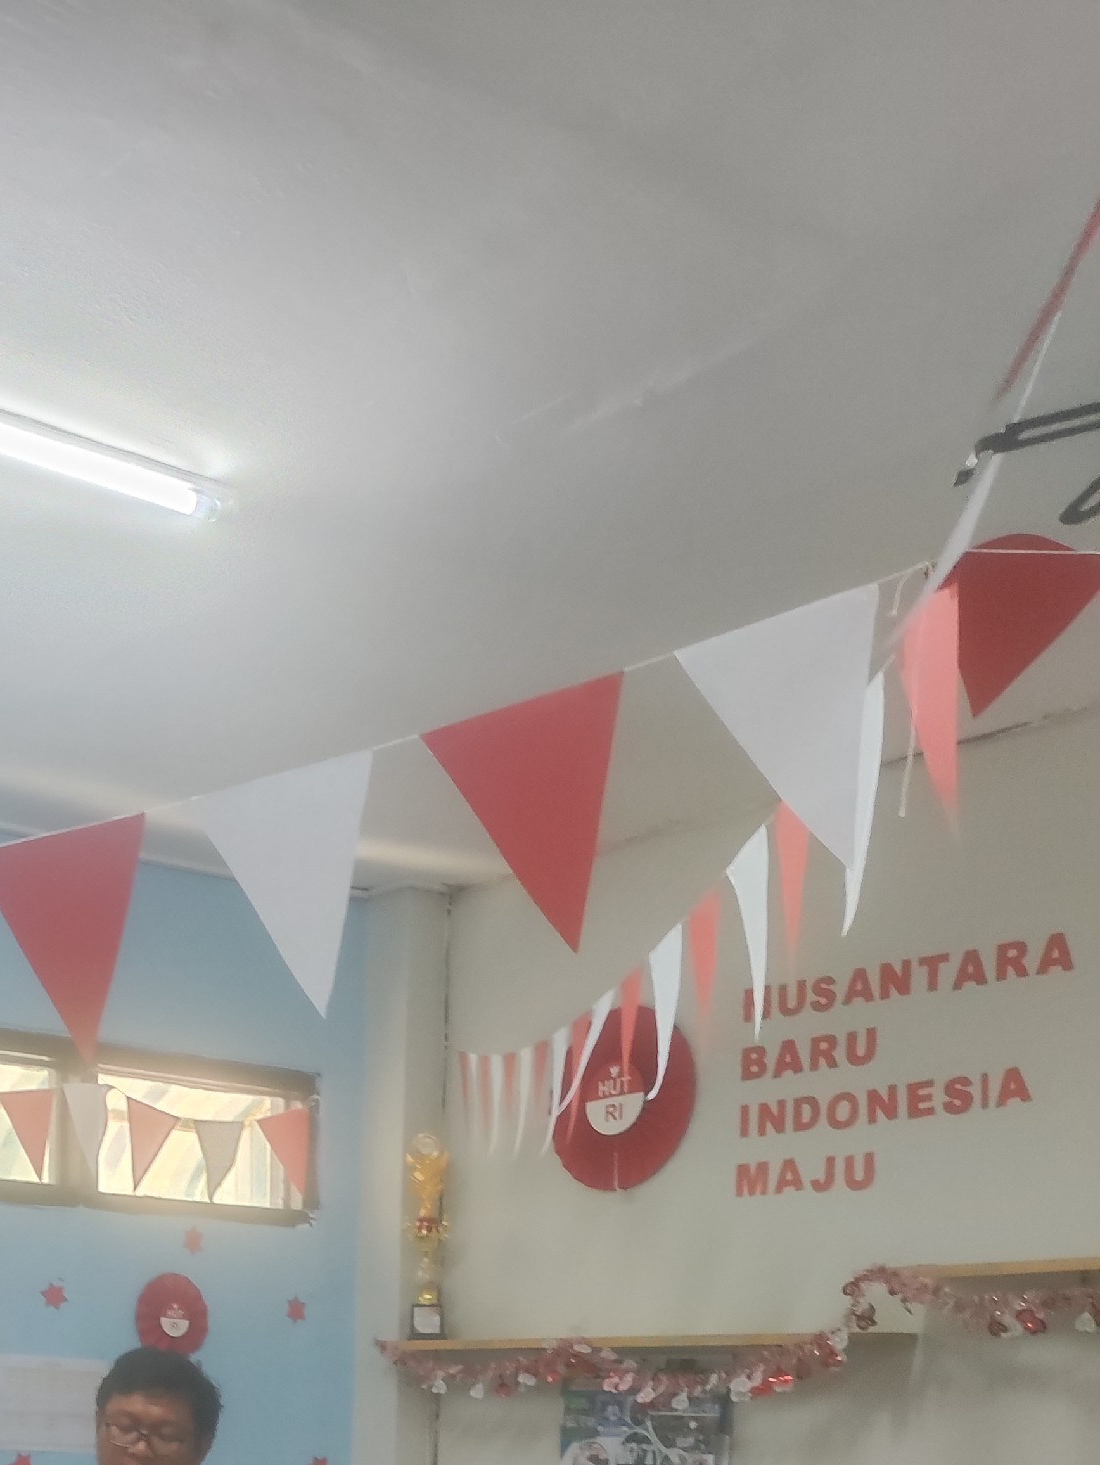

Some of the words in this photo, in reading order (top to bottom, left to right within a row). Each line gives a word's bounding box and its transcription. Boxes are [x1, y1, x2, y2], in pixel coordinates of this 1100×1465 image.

[742, 931, 1075, 1023] NUSANTARA
[740, 1027, 878, 1081] BARU
[598, 1076, 632, 1098] HUT
[739, 1065, 1032, 1139] INDONESIA
[605, 1103, 623, 1123] RI
[734, 1151, 876, 1198] MAJU
